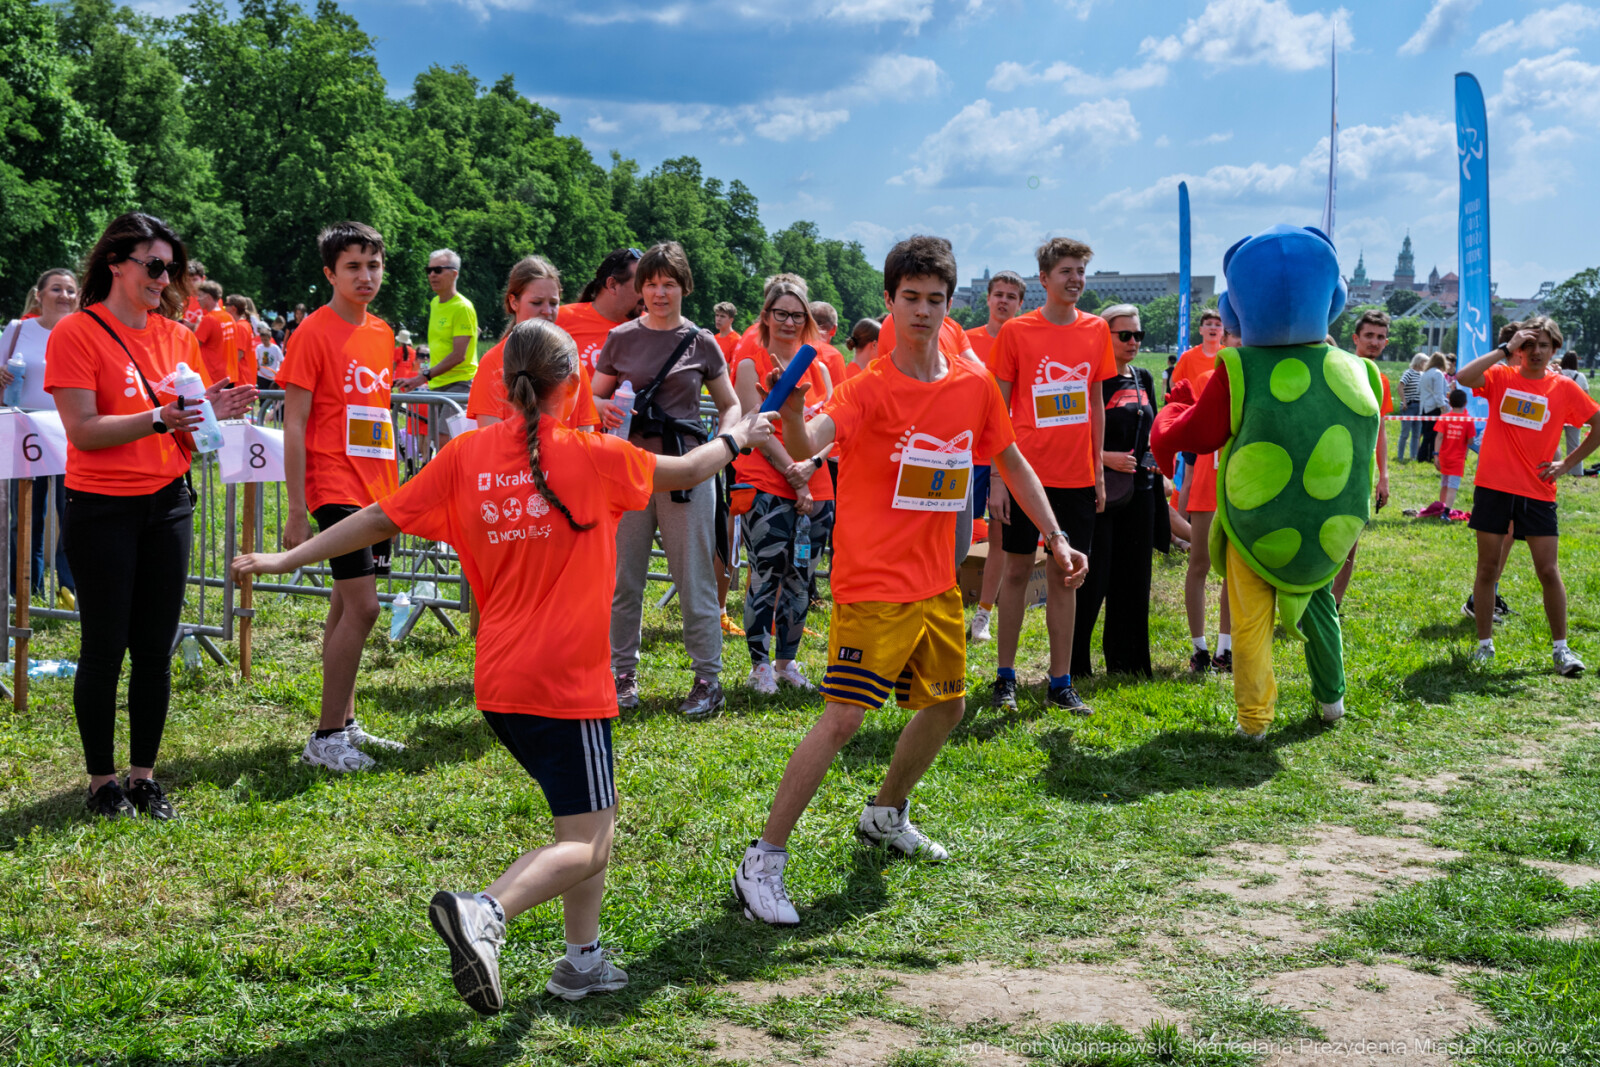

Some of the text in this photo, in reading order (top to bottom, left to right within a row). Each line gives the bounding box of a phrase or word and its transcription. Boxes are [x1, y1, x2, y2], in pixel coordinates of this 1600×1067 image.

[1053, 394, 1070, 410] 10
[1517, 400, 1531, 413] 18
[372, 422, 382, 440] 6
[22, 433, 43, 462] 6
[249, 443, 267, 469] 8
[495, 470, 549, 487] Krak
[930, 470, 957, 491] 8 6
[500, 529, 526, 542] MCPU
